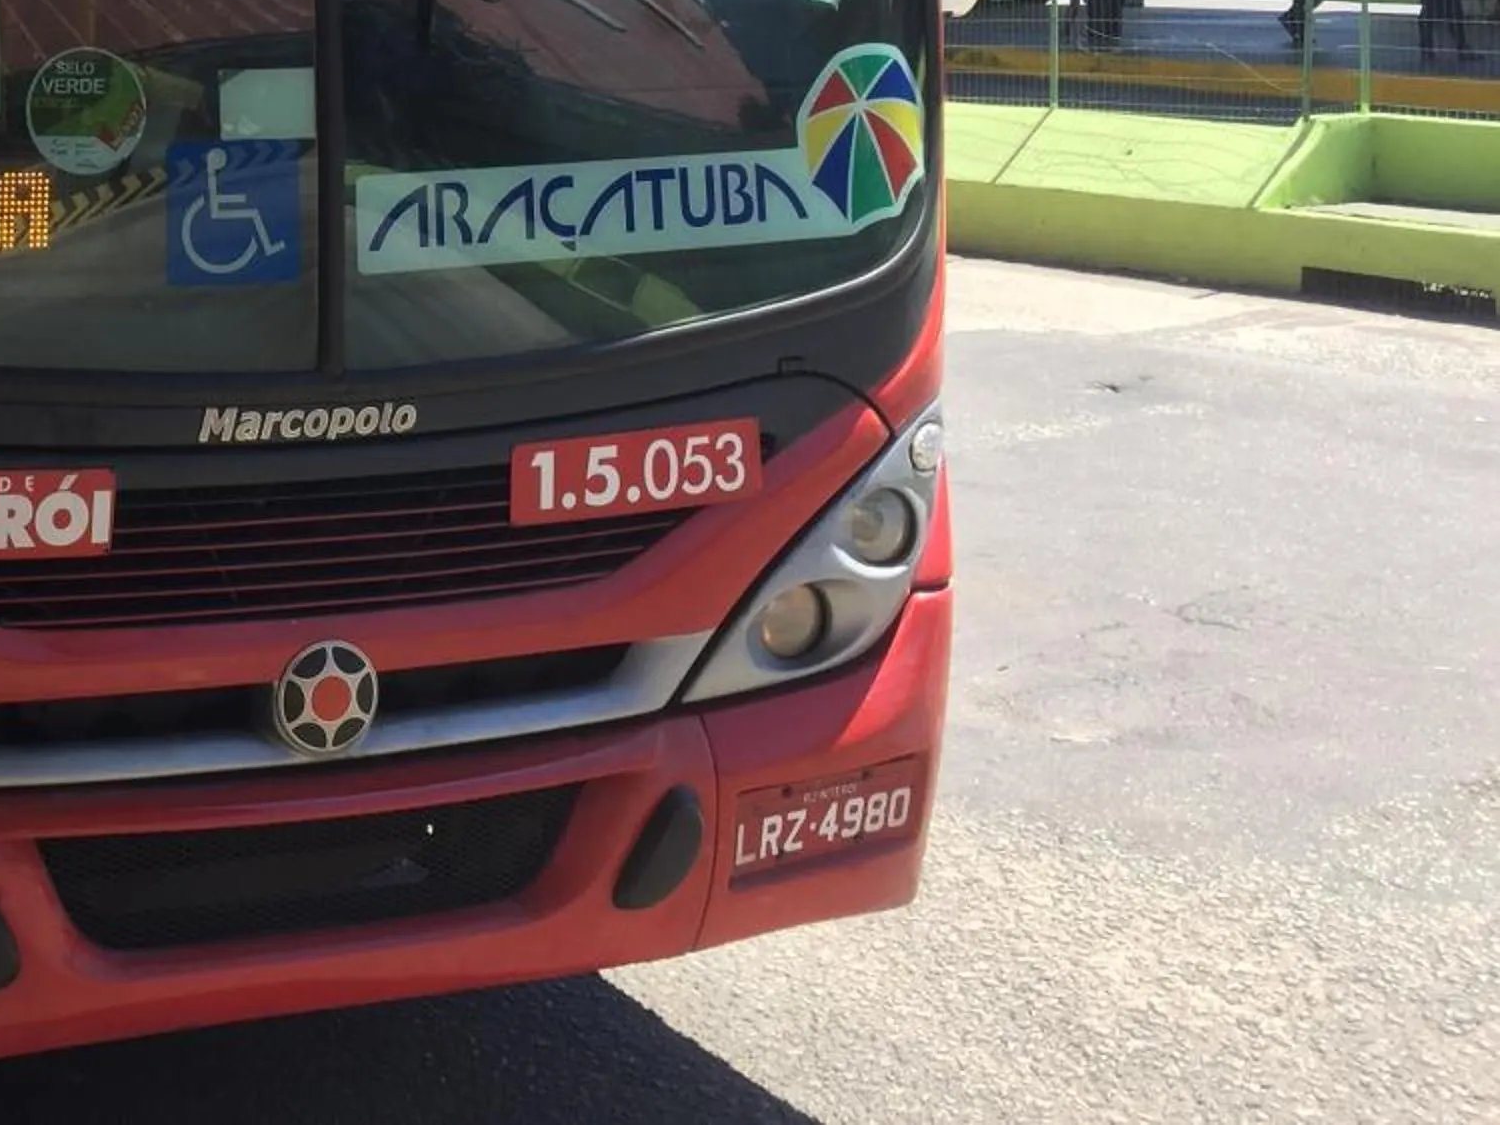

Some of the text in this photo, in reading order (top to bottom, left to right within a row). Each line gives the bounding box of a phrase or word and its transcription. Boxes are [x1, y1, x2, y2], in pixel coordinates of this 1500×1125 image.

[41, 77, 107, 94] VERDE
[55, 60, 95, 75] SELO
[369, 162, 809, 252] ARAÇATUBA
[199, 402, 418, 443] Marcopolo
[531, 432, 746, 511] 1.5.053
